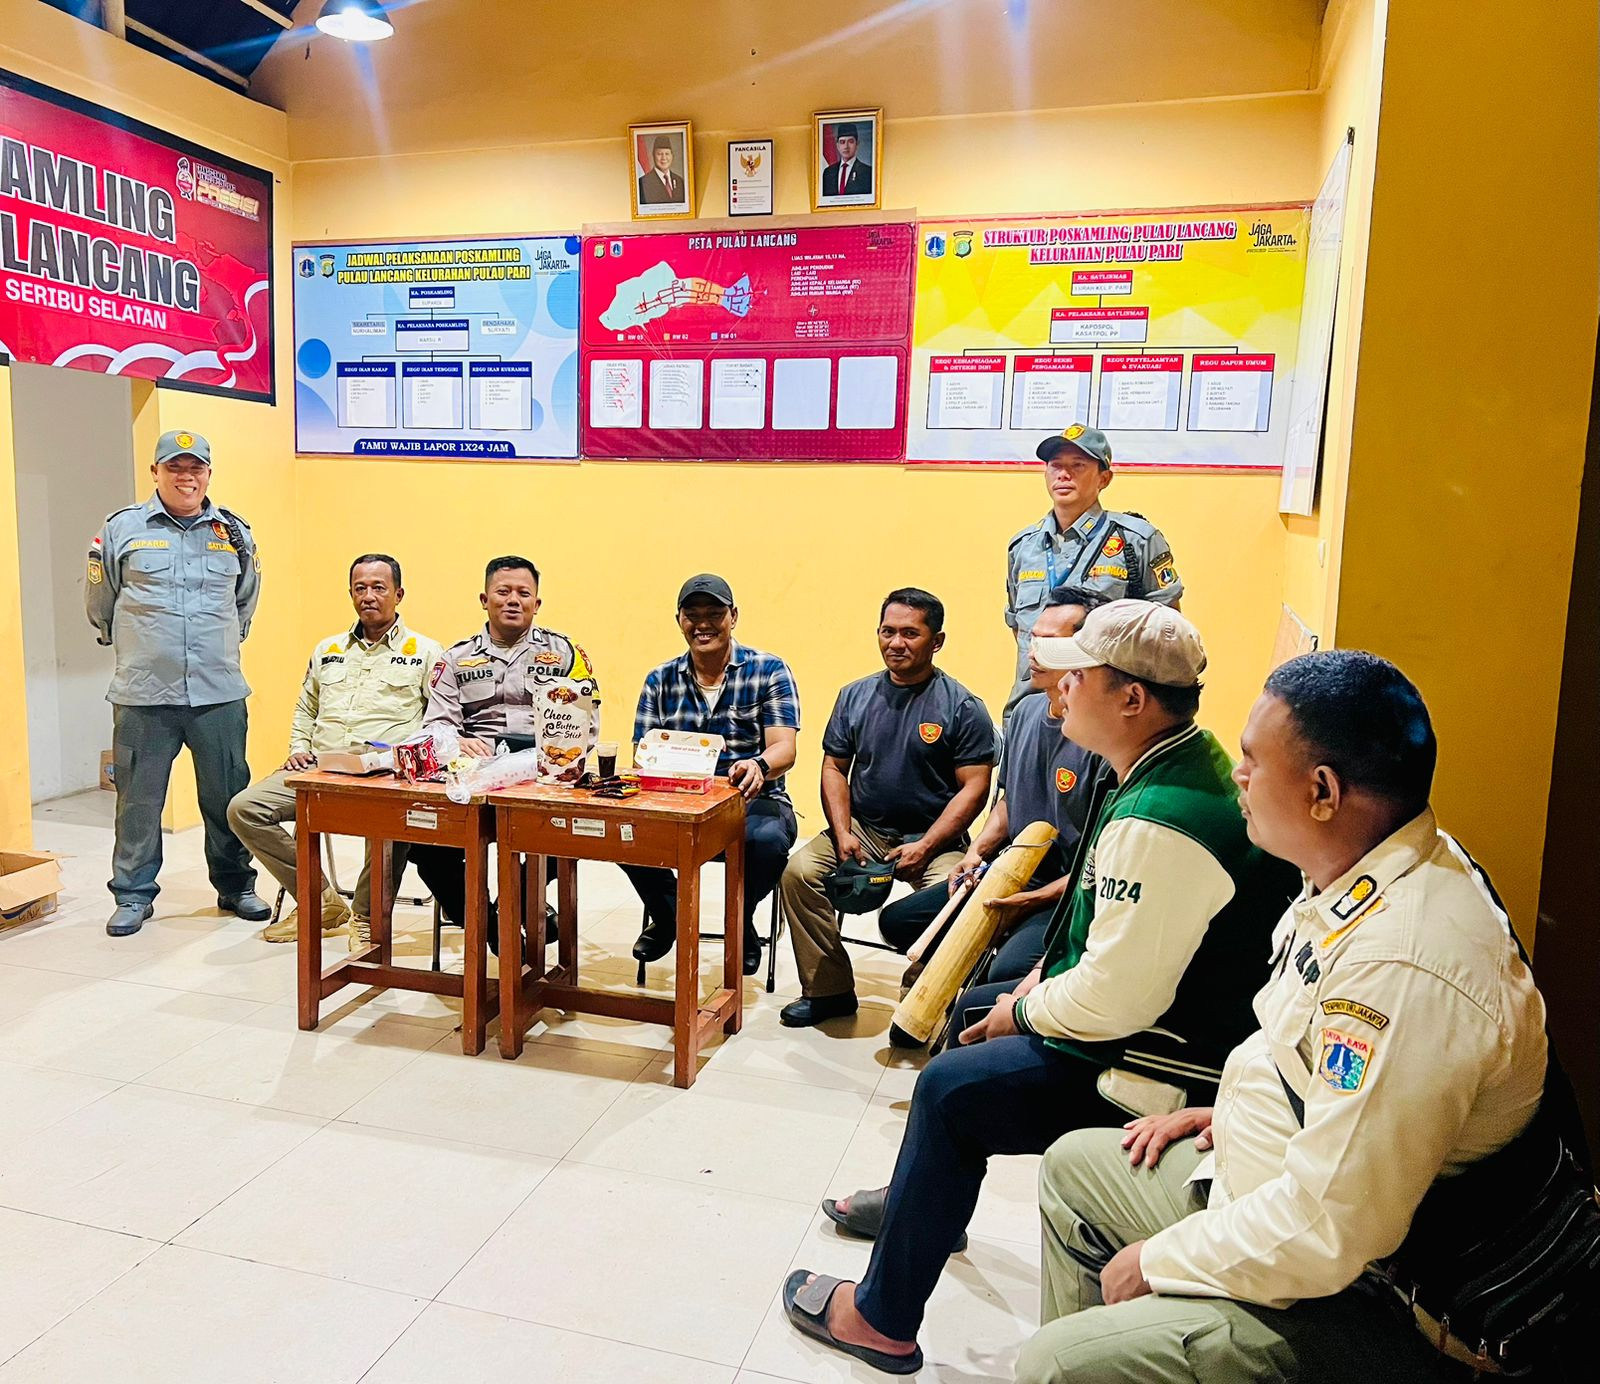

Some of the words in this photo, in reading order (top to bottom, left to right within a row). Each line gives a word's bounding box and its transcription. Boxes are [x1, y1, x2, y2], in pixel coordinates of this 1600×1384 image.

[0, 136, 176, 243] AMLING
[984, 229, 1046, 245] STRUKTUR
[1050, 226, 1129, 243] POSKAMLING
[1132, 224, 1174, 240] PULAU
[1176, 222, 1236, 238] LANCANG
[1249, 223, 1272, 236] JAGA
[689, 237, 712, 249] PETA
[716, 235, 747, 249] PULAU
[750, 233, 797, 247] LANCANG
[347, 253, 384, 267] JADWAL
[386, 250, 453, 266] PELAKSANAAN
[455, 248, 520, 263] POSKAMLING
[535, 249, 552, 260] JAGA
[1030, 246, 1107, 262] KELURAHAN
[1106, 245, 1146, 260] PULAU
[1149, 244, 1182, 259] PARI
[0, 211, 200, 312] LANCANG
[337, 270, 368, 284] PULAU
[369, 269, 413, 283] LANCANG
[415, 267, 471, 282] KELURAHAN
[473, 266, 505, 281] PULAU
[507, 265, 531, 280] PARI
[5, 279, 84, 313] SERIBU
[88, 299, 167, 330] SELATAN
[390, 442, 421, 450] WAJIB
[424, 442, 456, 451] LAPOR
[460, 443, 484, 451] 1X24
[487, 443, 509, 452] JAM
[391, 656, 408, 665] POL
[410, 658, 423, 666] PP
[456, 669, 494, 685] TULUS
[528, 666, 565, 677] POLRI
[543, 708, 572, 720] Choco
[555, 721, 580, 731] Butter
[563, 731, 582, 739] Stick
[1100, 876, 1142, 904] 2024
[1355, 1006, 1385, 1027] JAKARTA
[1347, 1037, 1368, 1053] RAYA
